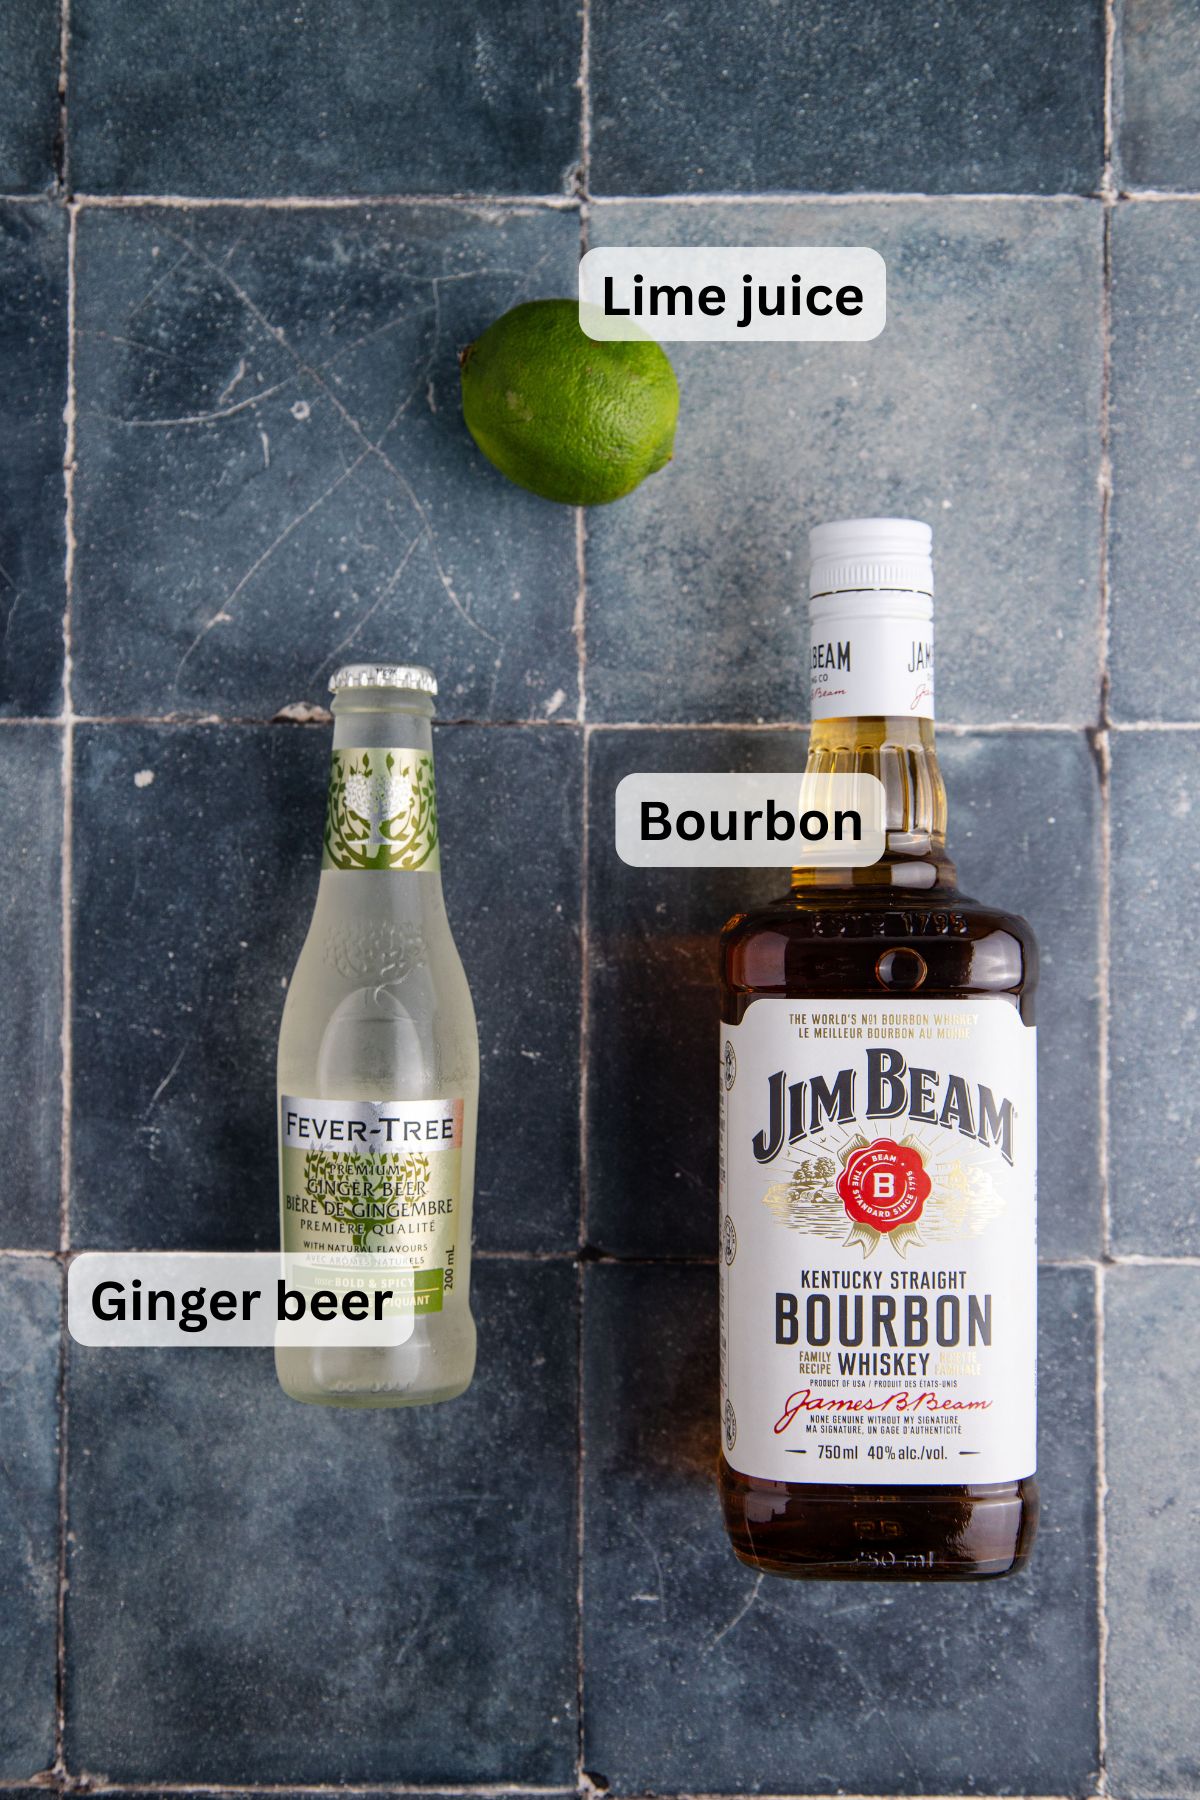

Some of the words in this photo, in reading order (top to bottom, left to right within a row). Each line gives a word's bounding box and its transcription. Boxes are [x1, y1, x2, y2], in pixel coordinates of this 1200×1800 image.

[901, 913, 968, 934] 1795
[789, 1014, 807, 1025] THE
[812, 1014, 857, 1025] WORLD'S
[882, 1014, 929, 1025] BOURBON
[799, 1027, 809, 1038] LE
[814, 1027, 863, 1039] MEILLEUR
[867, 1027, 914, 1039] BOURBON
[919, 1027, 932, 1039] AU
[752, 1069, 857, 1165] JIM
[865, 1048, 1015, 1167] BEAM
[287, 1112, 454, 1142] FEVER-TREE
[871, 1153, 897, 1163] BEAM
[329, 1163, 401, 1177] PREMIUM
[851, 1170, 863, 1187] THE
[306, 1178, 374, 1197] GINGER
[382, 1180, 427, 1197] BEER
[873, 1172, 895, 1198] B
[906, 1170, 917, 1191] 1795
[286, 1195, 318, 1215] BIÈRE
[324, 1202, 345, 1217] DE
[351, 1198, 454, 1218] GINGEMBRE
[852, 1189, 891, 1218] STANDARD
[892, 1193, 914, 1215] SINCE
[300, 1218, 365, 1235] PREMIÈRE
[372, 1219, 436, 1237] QUALITÉ
[303, 1240, 325, 1250] WITH
[327, 1242, 373, 1253] NATURAL
[377, 1243, 428, 1253] FLAVOURS
[335, 1277, 365, 1288] BOLD
[368, 1278, 377, 1289] &
[380, 1277, 415, 1289] SPICY
[444, 1268, 454, 1291] 200
[801, 1270, 883, 1290] KENTUCKY
[890, 1270, 967, 1290] STRAIGHT
[775, 1292, 992, 1348] BOURBON
[799, 1351, 832, 1363] FAMILY
[838, 1352, 930, 1376] WHISKEY
[799, 1363, 832, 1375] RECIPE
[809, 1379, 839, 1388] PRODUCT
[842, 1379, 851, 1388] OF
[852, 1379, 866, 1388] USA
[874, 1379, 902, 1388] PRODUIT
[904, 1379, 917, 1388] DES
[919, 1378, 958, 1388] ÉTATS-UNIS
[774, 1388, 881, 1434] James
[810, 1415, 830, 1424] NONE
[832, 1415, 864, 1424] GENUINE
[867, 1415, 901, 1424] WITHOUT
[903, 1415, 915, 1424] MY
[917, 1415, 959, 1424] SIGNATURE
[805, 1425, 818, 1434] MA
[820, 1425, 865, 1435] SIGNATURE,
[867, 1425, 877, 1434] UN
[880, 1425, 900, 1434] GAGE
[903, 1424, 962, 1435] D'AUTHENTICITÉ
[867, 1444, 896, 1460] 40%
[898, 1444, 948, 1461] alc./vol.
